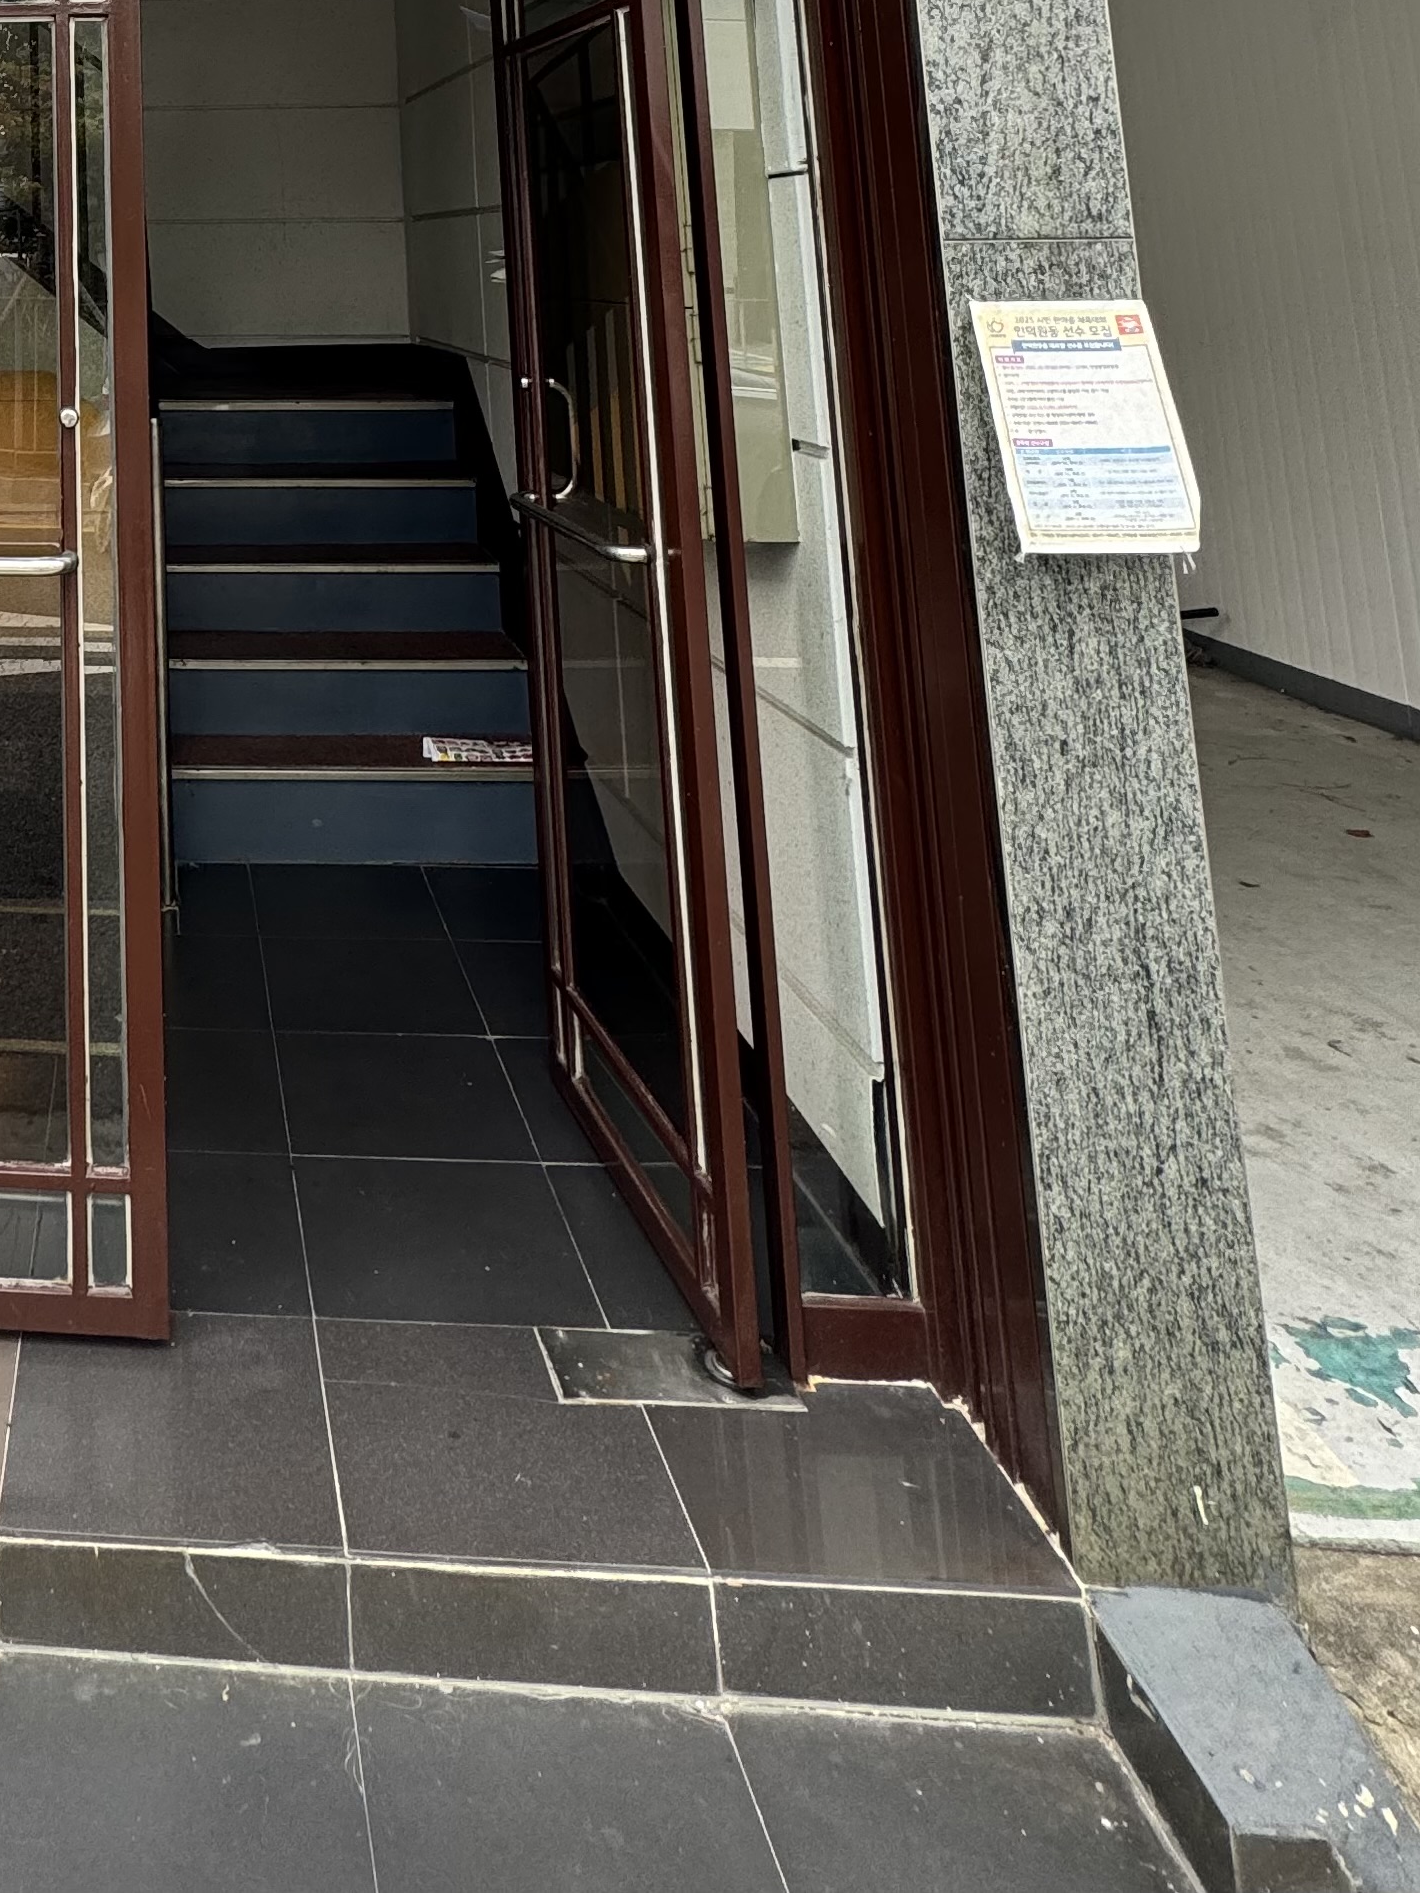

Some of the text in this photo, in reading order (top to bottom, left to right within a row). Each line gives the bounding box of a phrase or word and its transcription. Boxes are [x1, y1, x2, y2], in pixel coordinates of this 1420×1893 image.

[1013, 324, 1113, 337] 인덕원동 선수 모집
